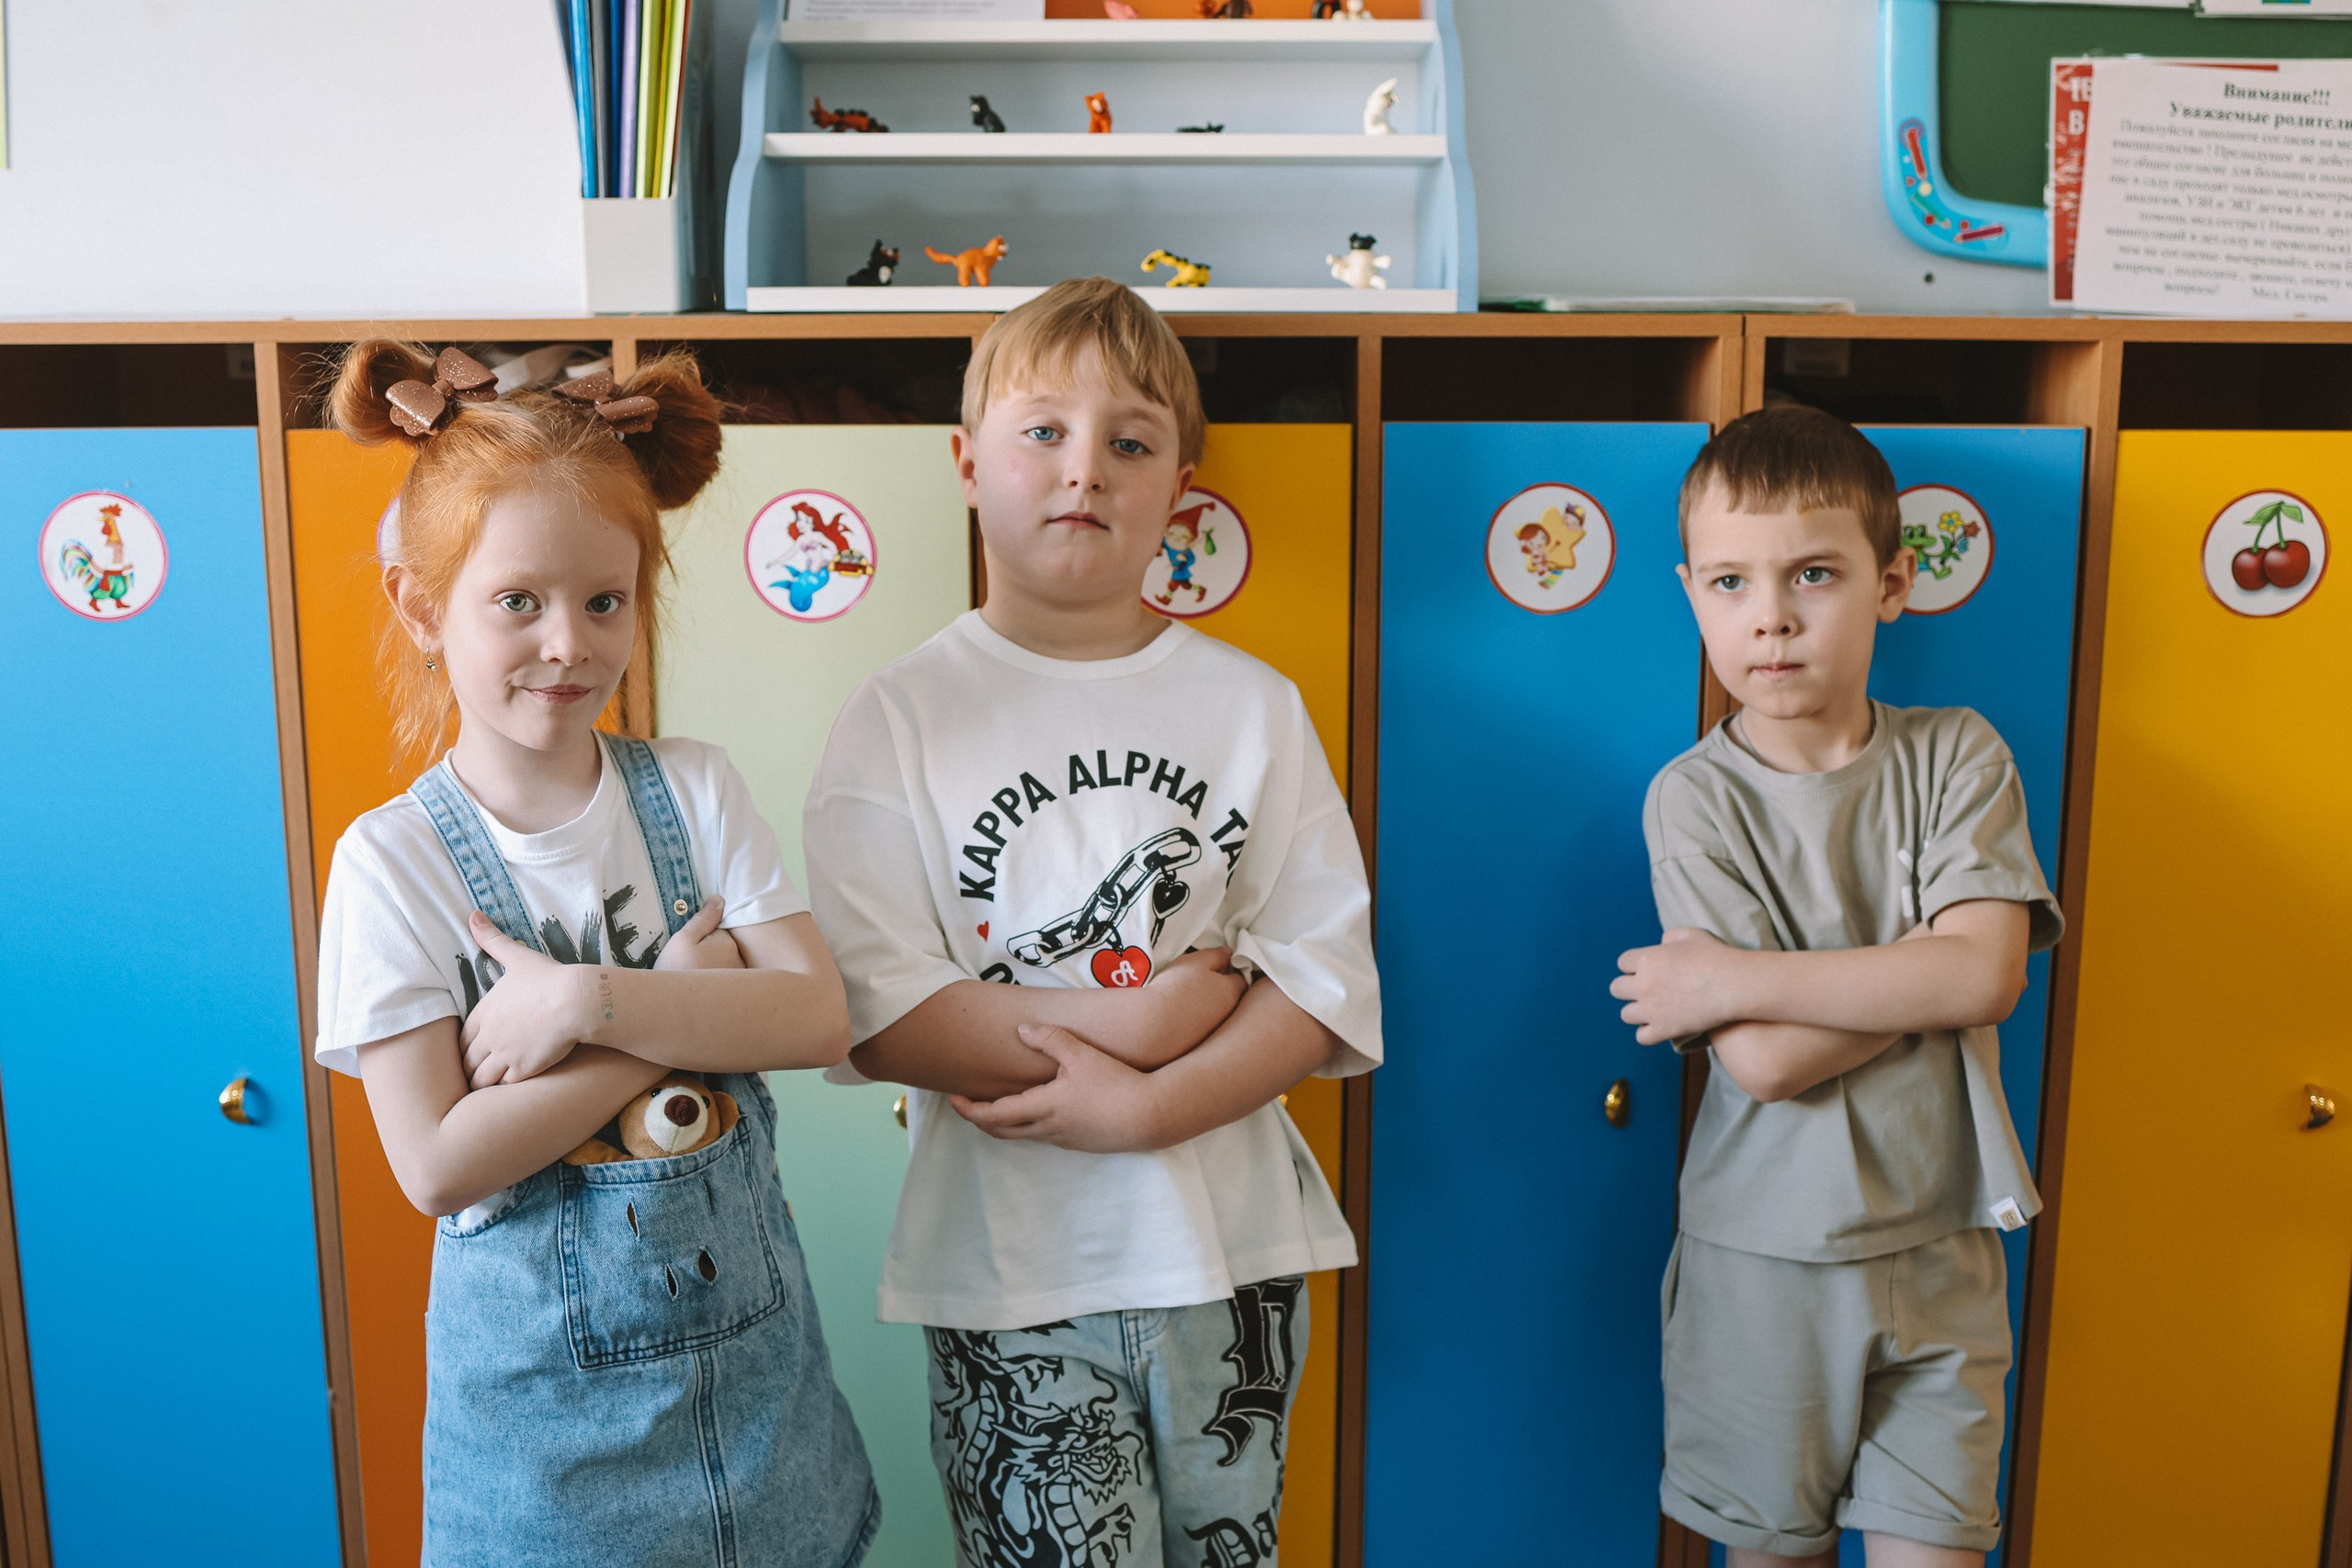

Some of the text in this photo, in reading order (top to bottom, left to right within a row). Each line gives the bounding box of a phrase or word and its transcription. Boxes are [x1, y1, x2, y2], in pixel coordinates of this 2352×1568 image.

[959, 750, 1250, 902] KAPPA ALPHA TA
